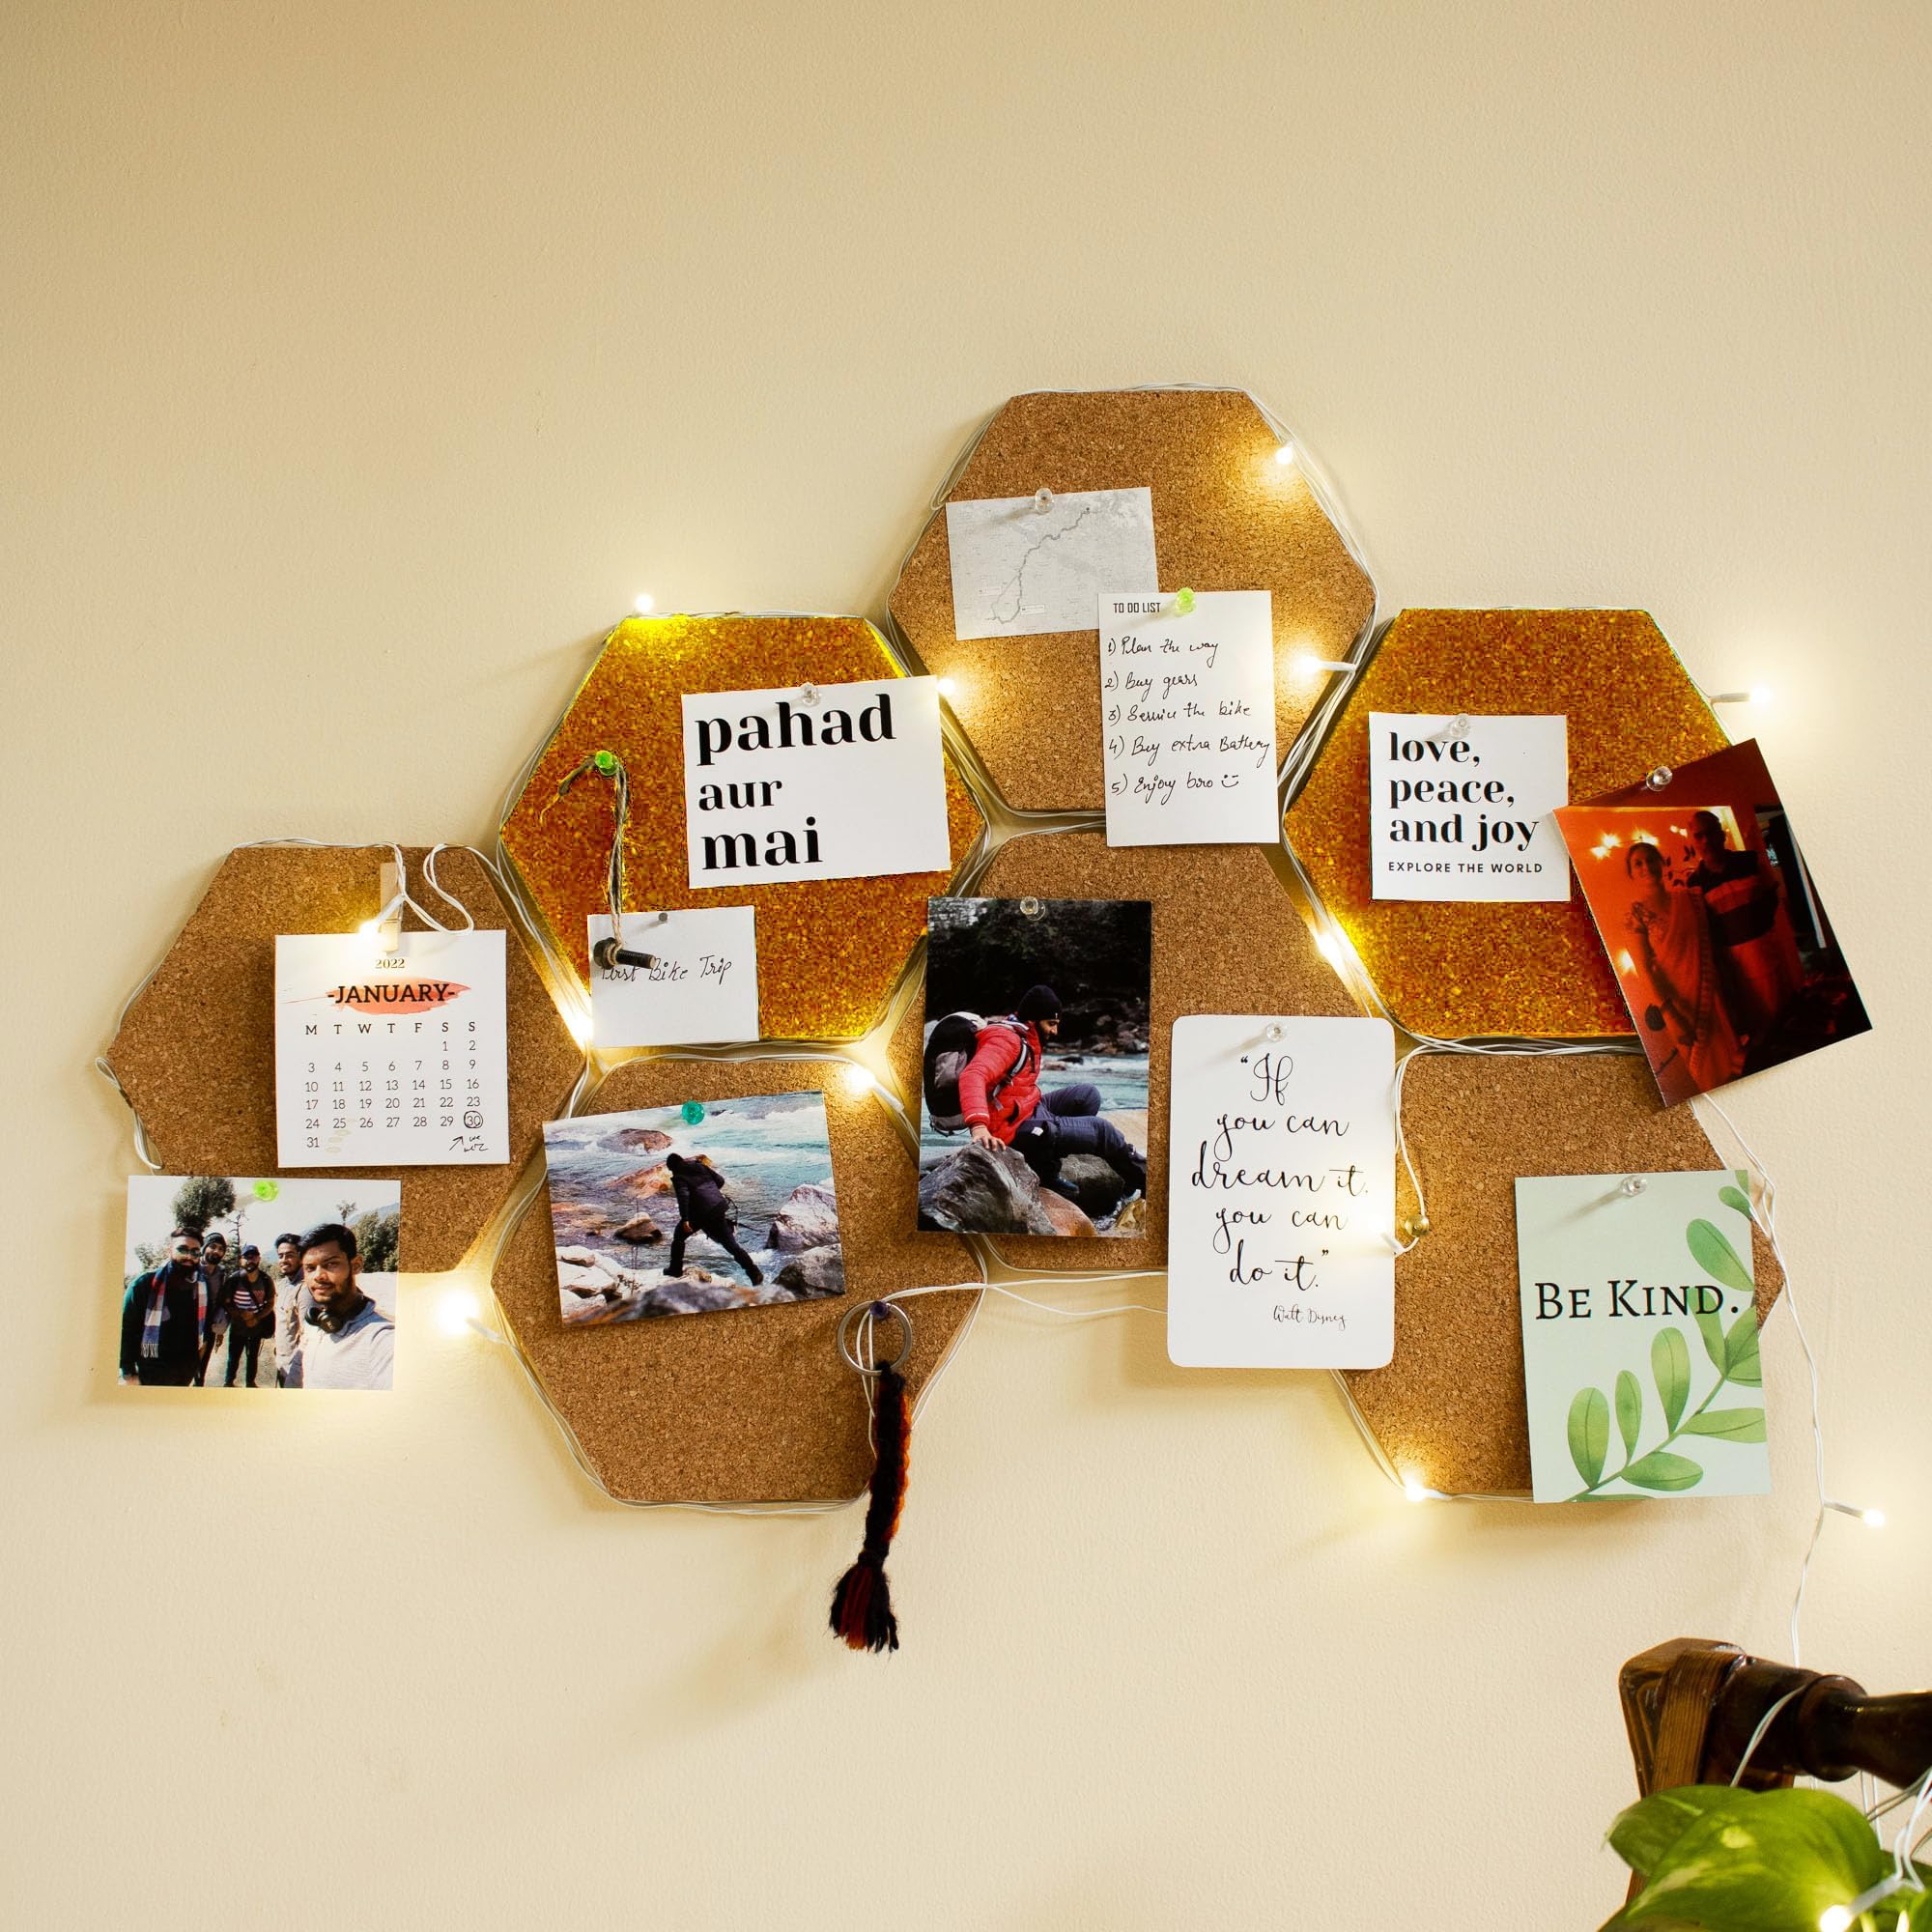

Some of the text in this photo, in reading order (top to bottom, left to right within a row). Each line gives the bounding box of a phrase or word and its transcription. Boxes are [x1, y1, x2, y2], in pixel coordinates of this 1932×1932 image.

[1113, 603, 1160, 612] TO DO LIST
[1108, 636, 1218, 668] 1) Plan the way
[1104, 670, 1119, 692] 2)
[1125, 672, 1152, 702] Buy
[1108, 704, 1121, 726] 3)
[1183, 702, 1205, 717] the
[1219, 700, 1250, 716] bike
[695, 694, 896, 766] pahad
[1109, 734, 1269, 768] 4) Buy extra Battery
[1389, 732, 1480, 767] love,
[699, 781, 782, 810] aur
[1112, 772, 1212, 806] 5) Enjoy bro
[1389, 780, 1515, 809] peace,
[701, 816, 823, 869] mai
[1390, 814, 1539, 851] and joy
[1389, 862, 1542, 872] EXPLORE THE WORLD
[376, 958, 405, 968] 2022
[649, 958, 688, 980] Bike
[699, 955, 731, 984] Trip
[305, 1022, 475, 1035] M T W T F S S
[442, 1040, 475, 1051] 1 2
[308, 1060, 475, 1072] 3 4 5 6 7 8 9
[305, 1078, 479, 1092] 10 11 12 13 14 15 16
[306, 1096, 480, 1110] 17 18 19 20 21 22 23
[306, 1116, 480, 1128] 24 25 26 27 28 29 30
[307, 1137, 320, 1148] 31
[1214, 1114, 1349, 1163] you can
[1191, 1141, 1325, 1192] dream
[1213, 1208, 1349, 1256] you can
[1228, 1237, 1272, 1285] do
[1273, 1304, 1346, 1329] Walt Disney
